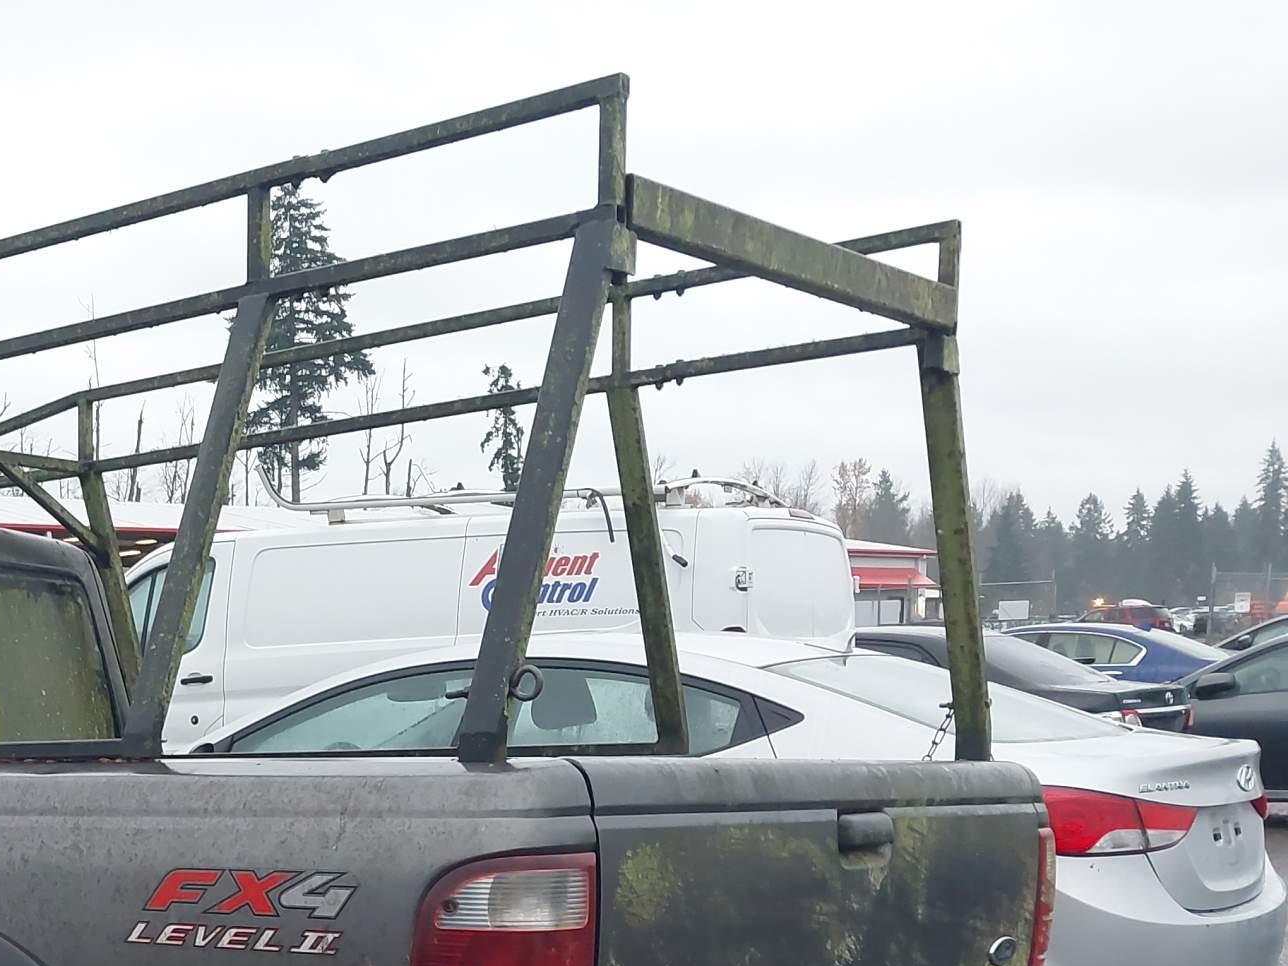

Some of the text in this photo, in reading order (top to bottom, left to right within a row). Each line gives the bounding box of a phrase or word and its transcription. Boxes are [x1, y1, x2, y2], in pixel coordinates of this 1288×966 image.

[142, 867, 359, 920] FX4
[124, 920, 344, 955] LEVEL II
